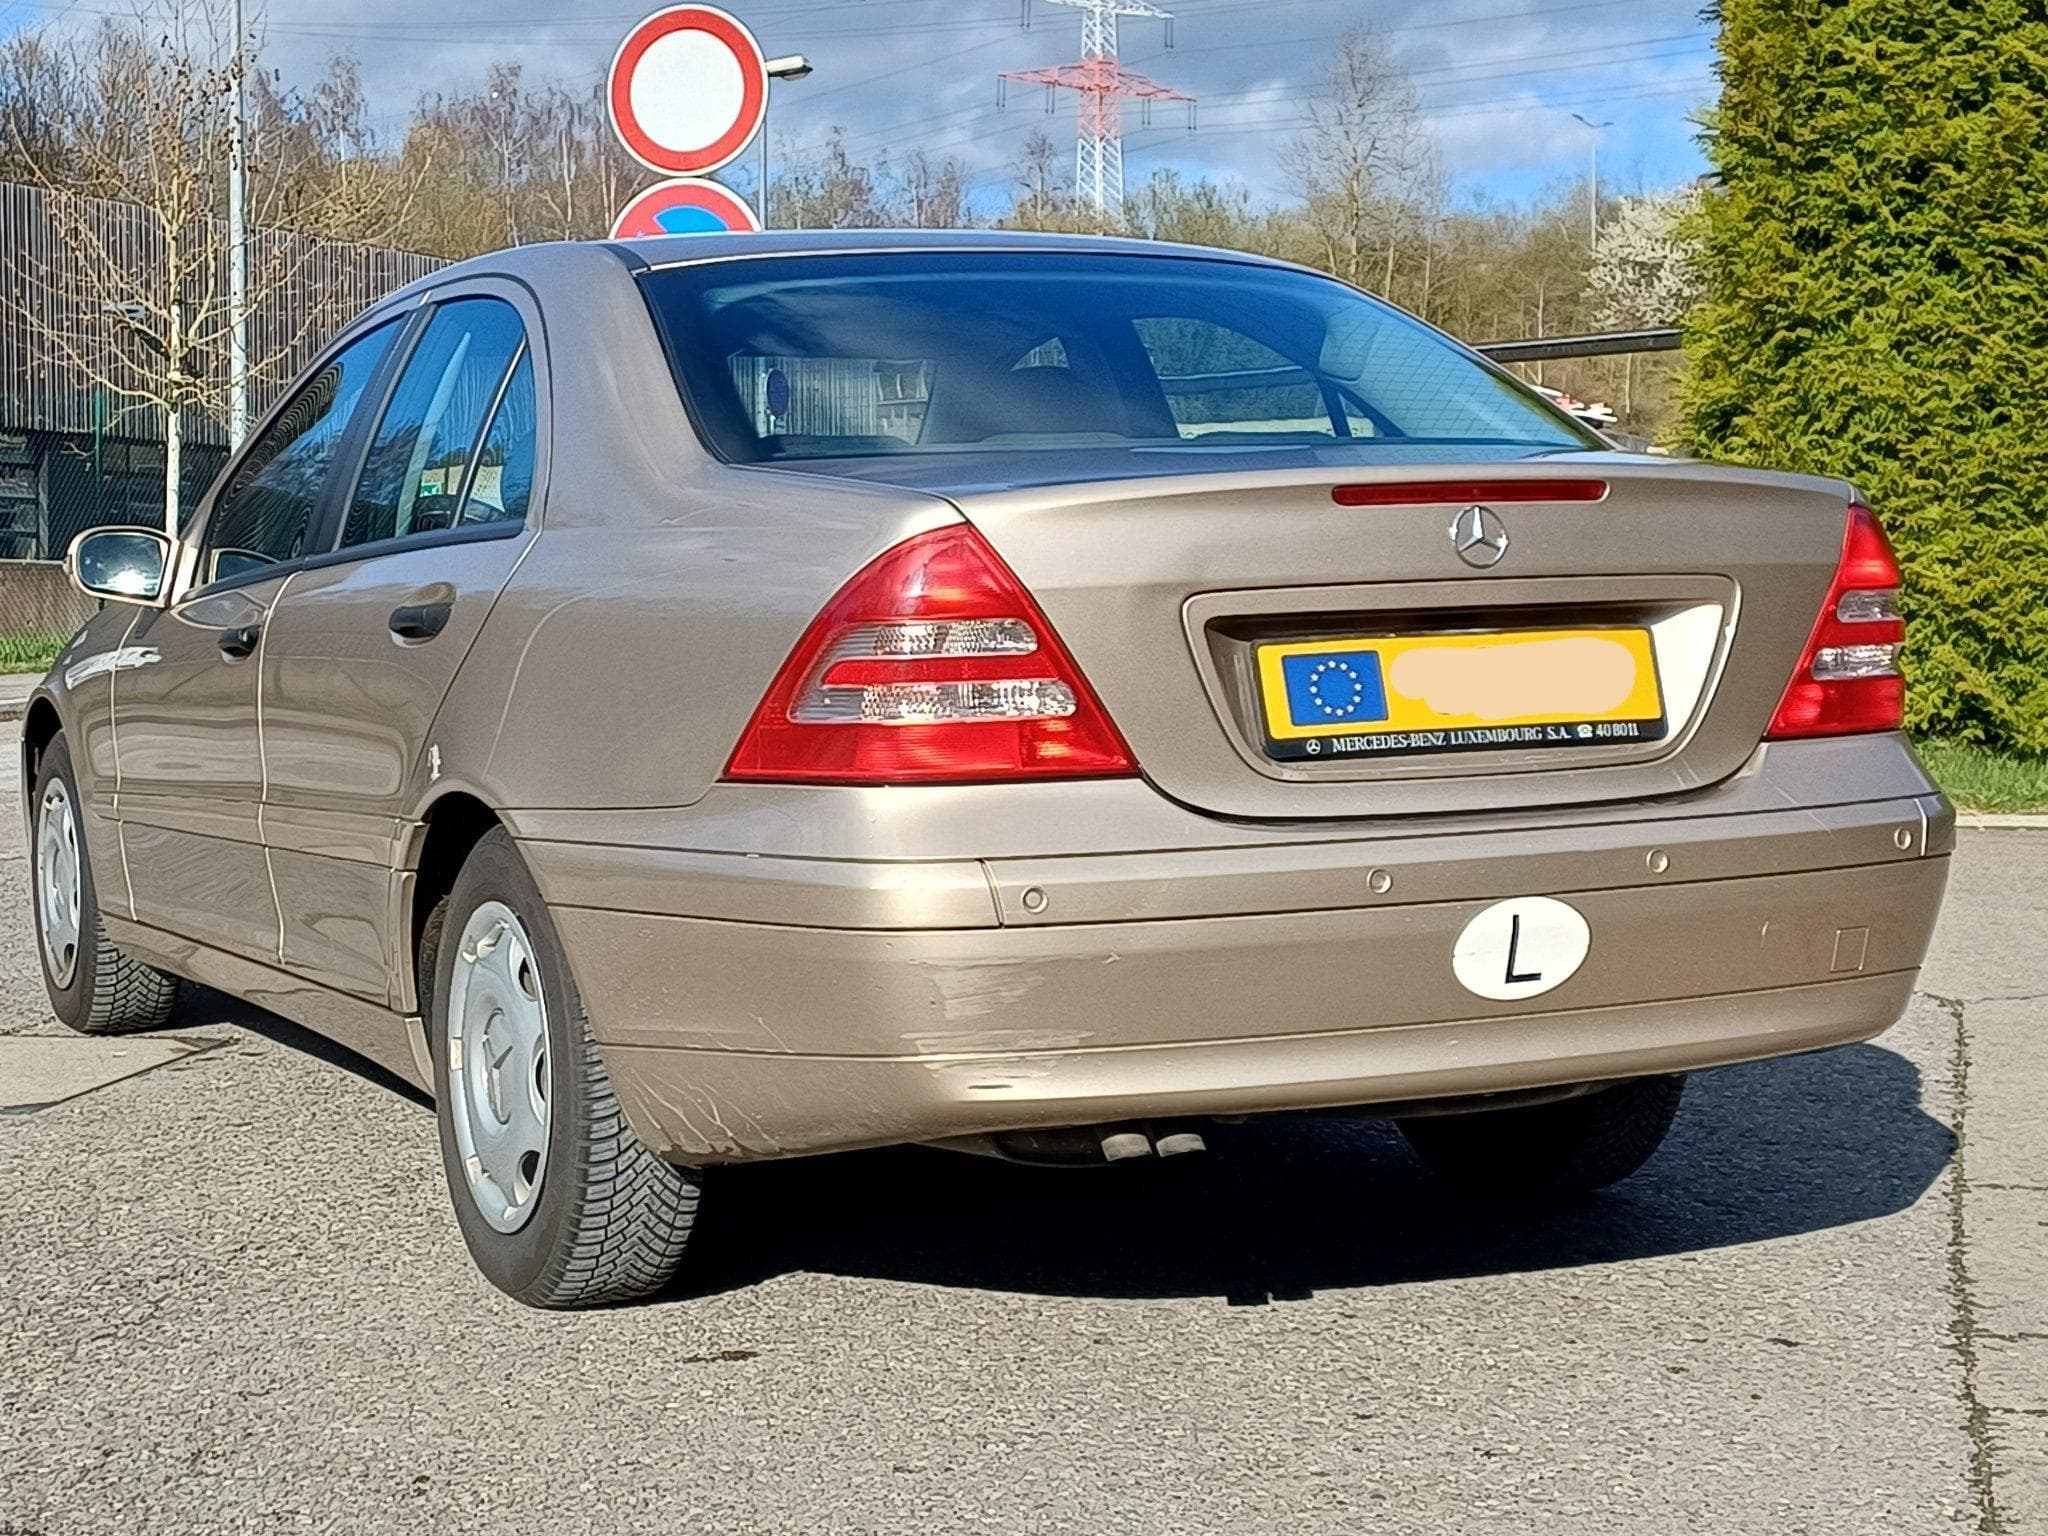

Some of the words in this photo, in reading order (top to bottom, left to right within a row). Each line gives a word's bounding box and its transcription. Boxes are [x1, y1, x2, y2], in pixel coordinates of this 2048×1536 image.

[1332, 732, 1446, 753] MERCEDES-BENZ
[1451, 727, 1543, 745] LUXEMBOURG
[1505, 914, 1542, 984] L
